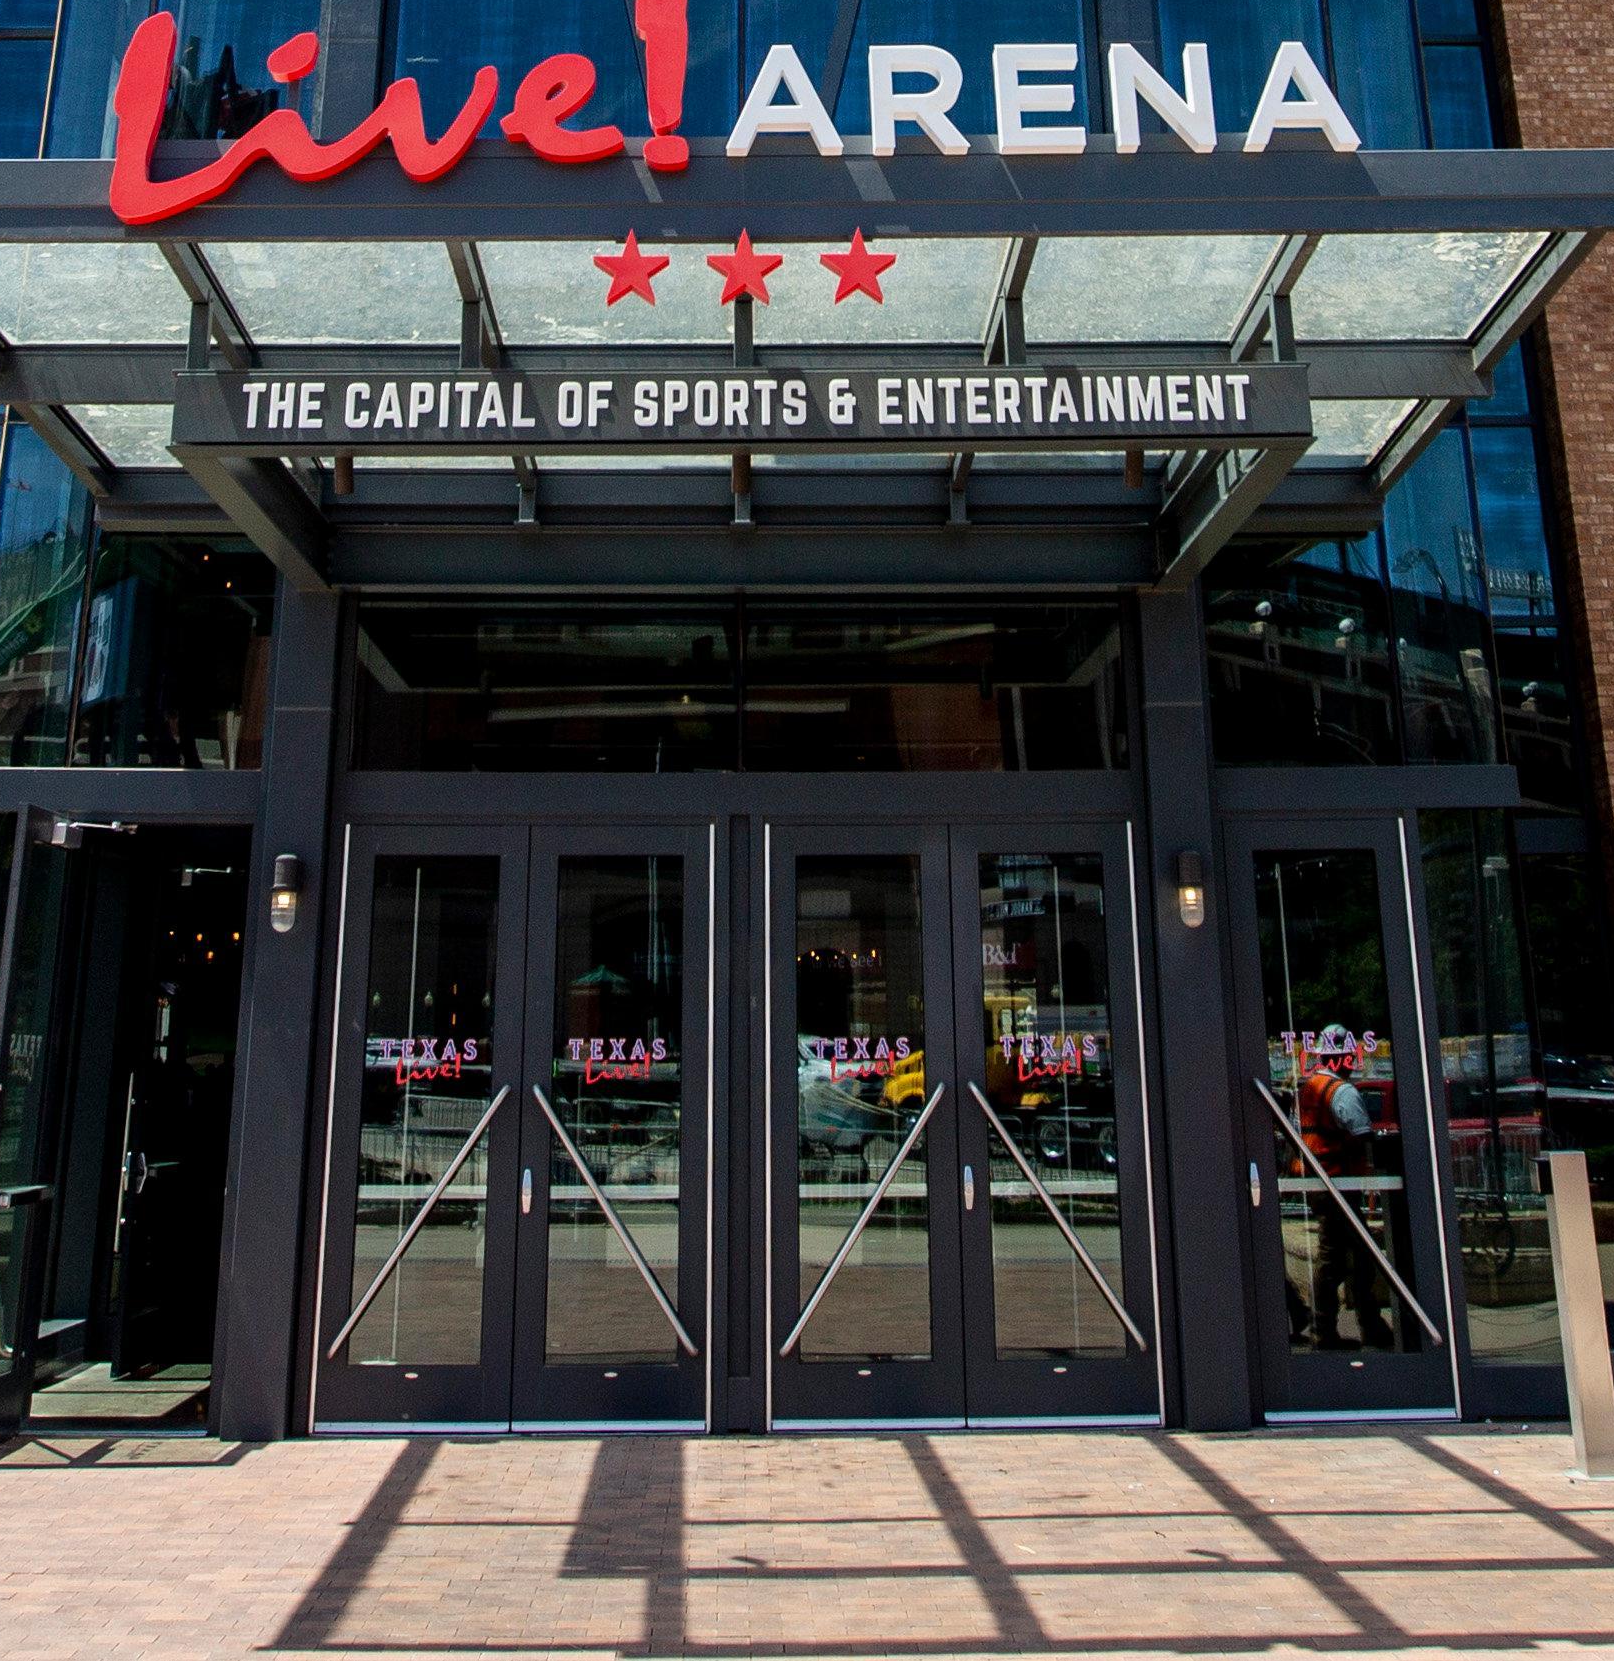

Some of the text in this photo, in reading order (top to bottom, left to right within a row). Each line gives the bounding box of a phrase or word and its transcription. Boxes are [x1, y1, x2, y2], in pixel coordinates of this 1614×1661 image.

[725, 41, 1361, 157] ARENA
[242, 374, 1251, 429] THE CAPITAL OF SPORTS & ENTERTAINMENT
[380, 1037, 477, 1060] TEXAS
[569, 1037, 667, 1060] TEXAS
[812, 1036, 910, 1059] TEXAS
[1000, 1034, 1096, 1058] TEXAS
[1281, 1030, 1377, 1053] TEXAS
[396, 1053, 462, 1085] Live!
[585, 1052, 651, 1085] Live!
[830, 1050, 896, 1083] Live!
[1018, 1048, 1082, 1081] Live!
[1298, 1043, 1365, 1077] Live!
